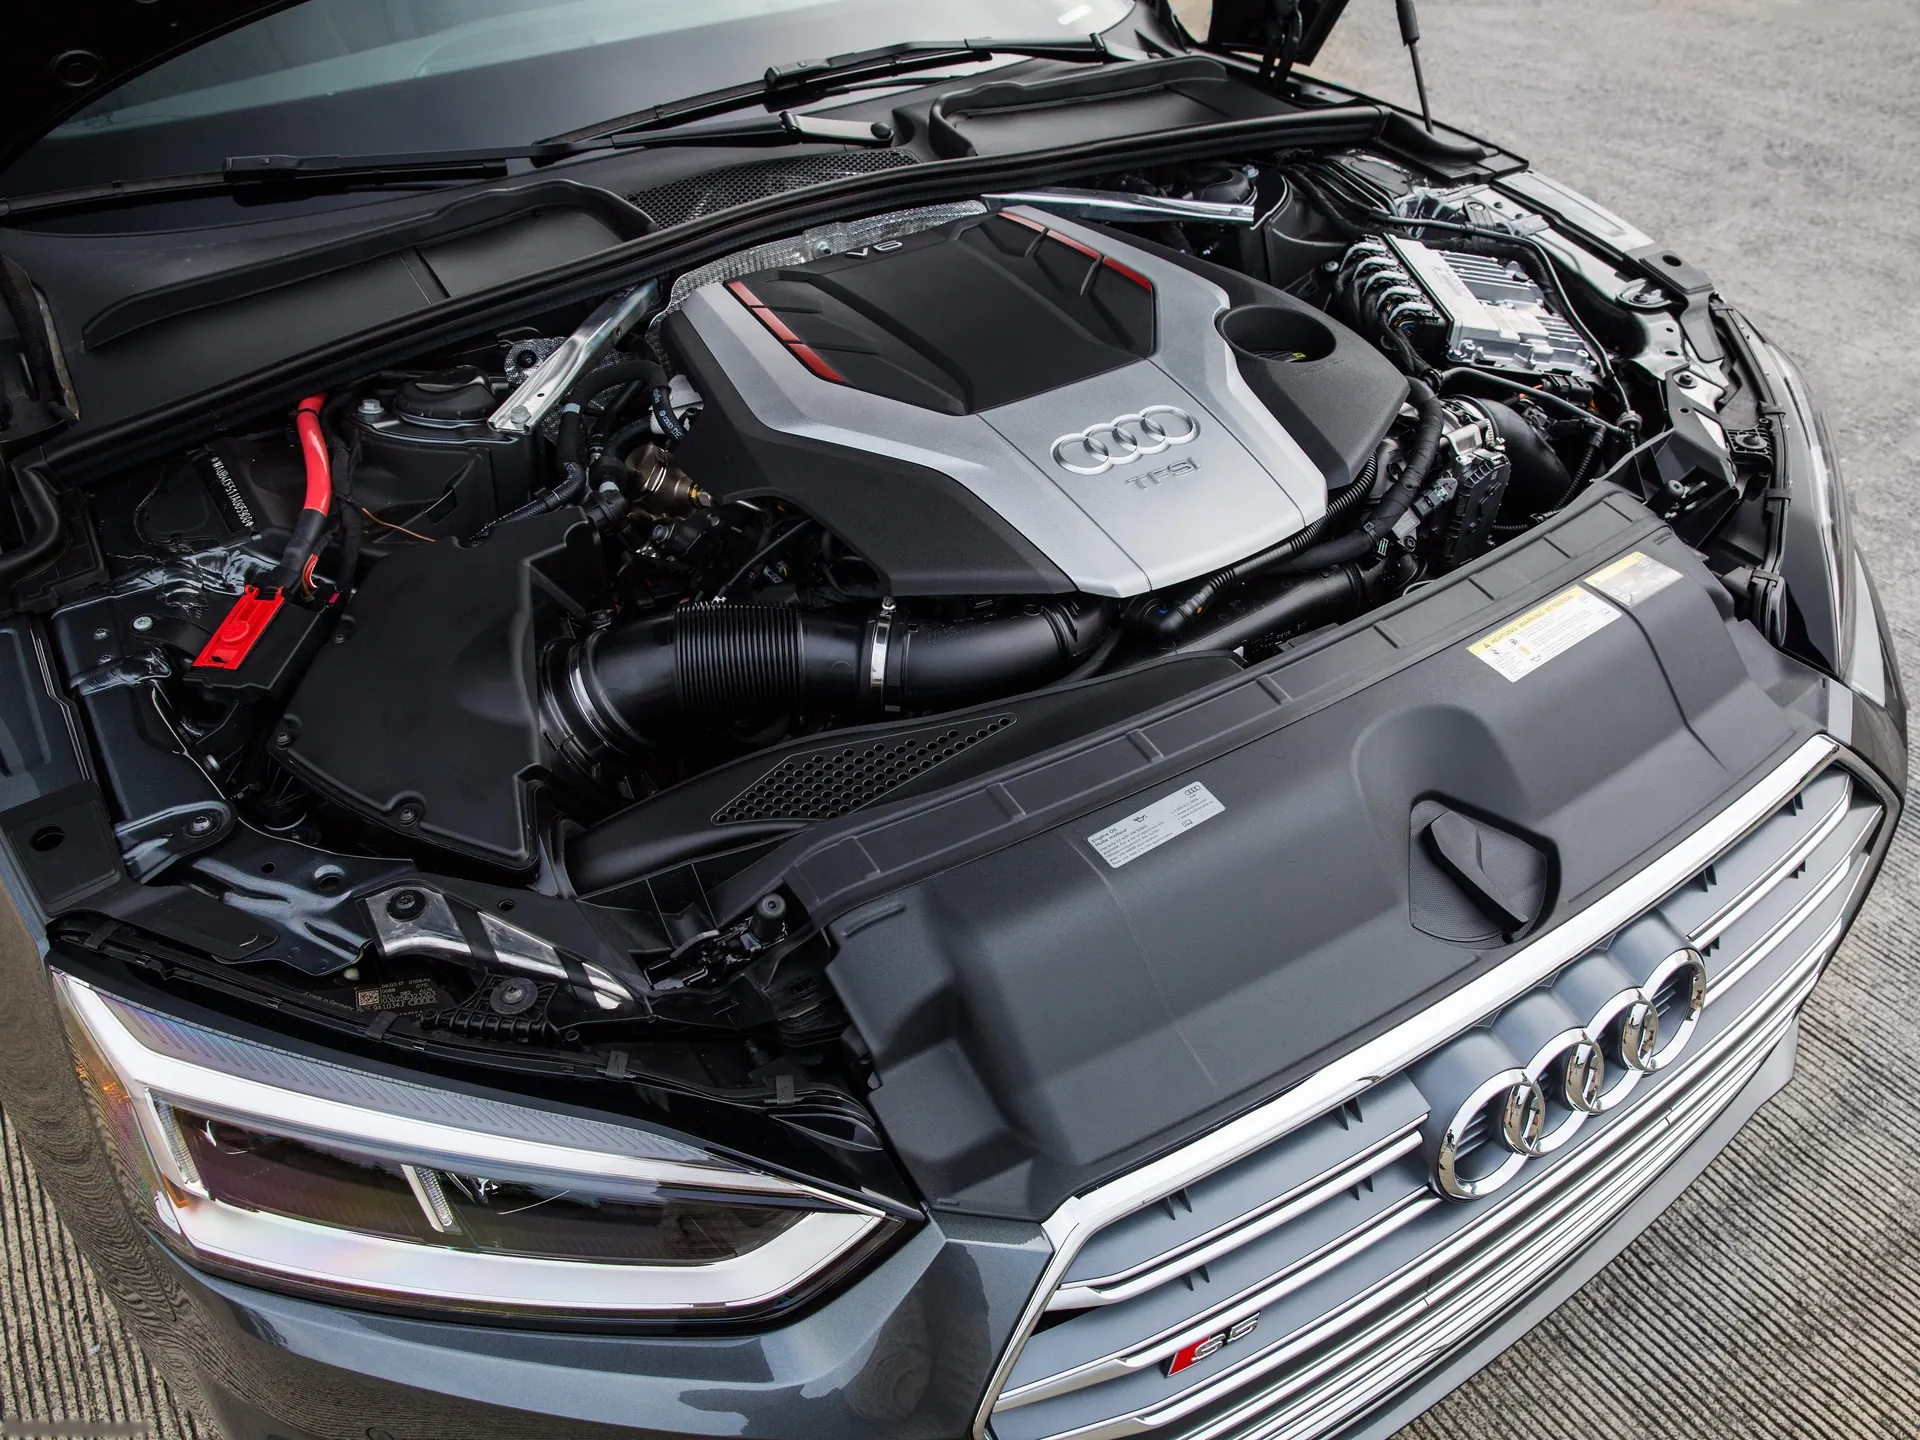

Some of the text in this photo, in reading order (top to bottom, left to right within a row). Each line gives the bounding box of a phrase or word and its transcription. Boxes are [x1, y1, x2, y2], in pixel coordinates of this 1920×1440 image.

[846, 240, 903, 257] V6
[1125, 457, 1201, 490] TFSI
[1491, 595, 1574, 644] ACHTUNG WARNING ATTENTION
[1091, 832, 1109, 844] Engine
[1094, 828, 1127, 847] Huile moteur
[329, 999, 355, 1011] Germany
[1191, 1312, 1261, 1362] S5
